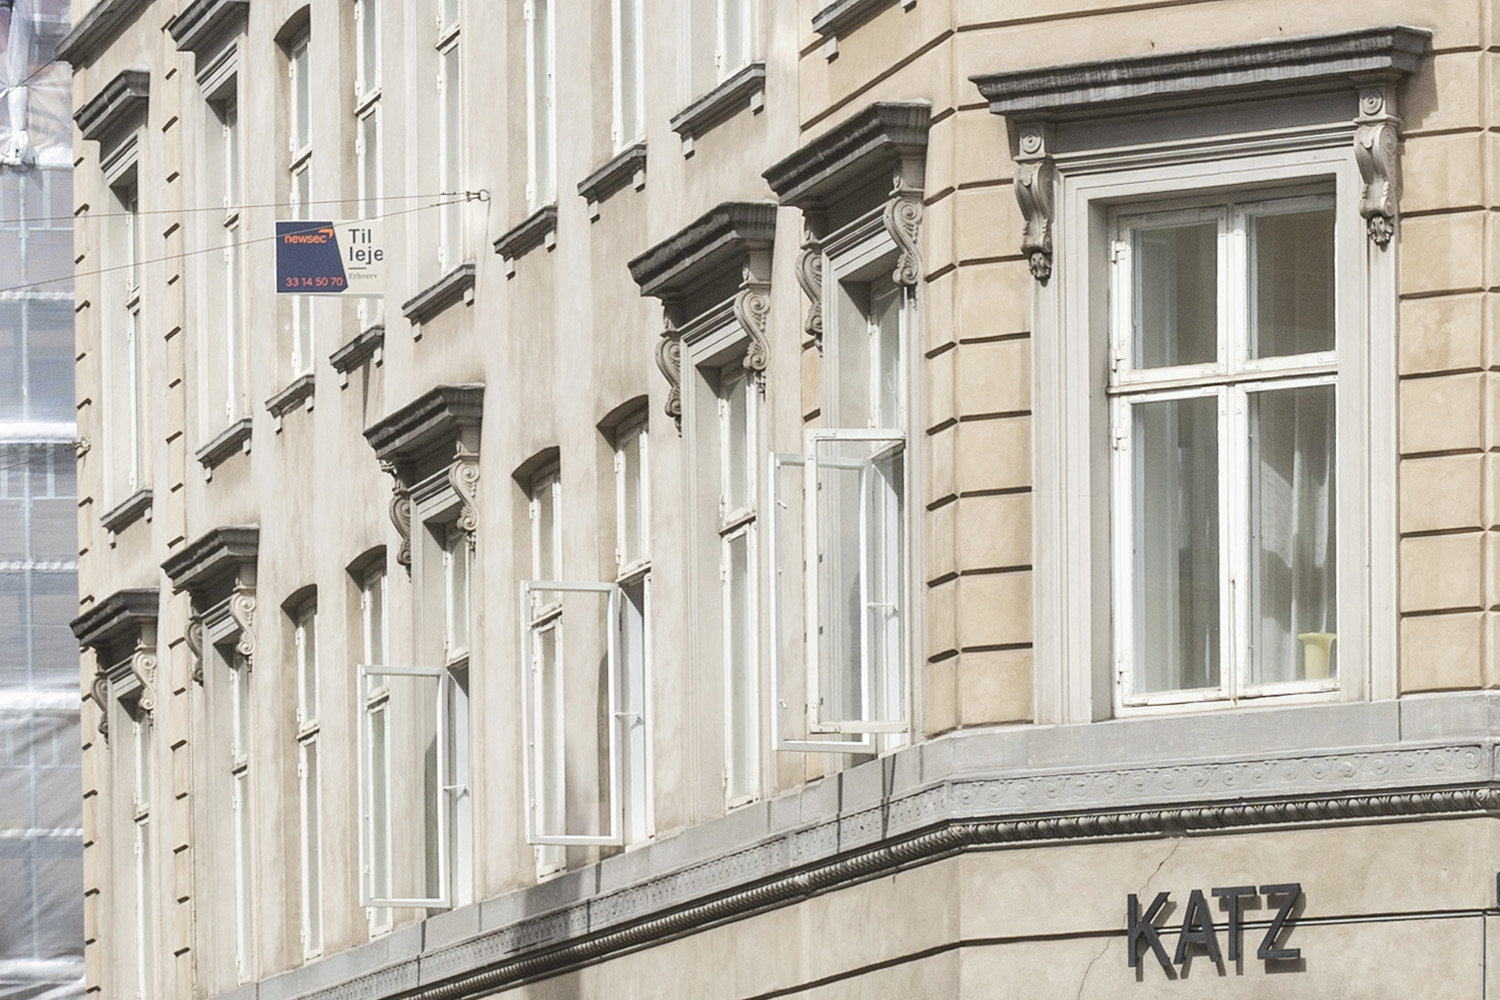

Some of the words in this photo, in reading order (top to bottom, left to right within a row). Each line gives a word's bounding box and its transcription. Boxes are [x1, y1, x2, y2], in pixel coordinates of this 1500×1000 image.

[284, 234, 327, 244] newsec
[348, 228, 372, 244] Til
[349, 246, 384, 265] leje
[286, 277, 299, 287] 33
[301, 277, 313, 287] 14
[315, 277, 328, 287] 50
[330, 277, 344, 287] 70
[1127, 883, 1301, 967] KATZ
